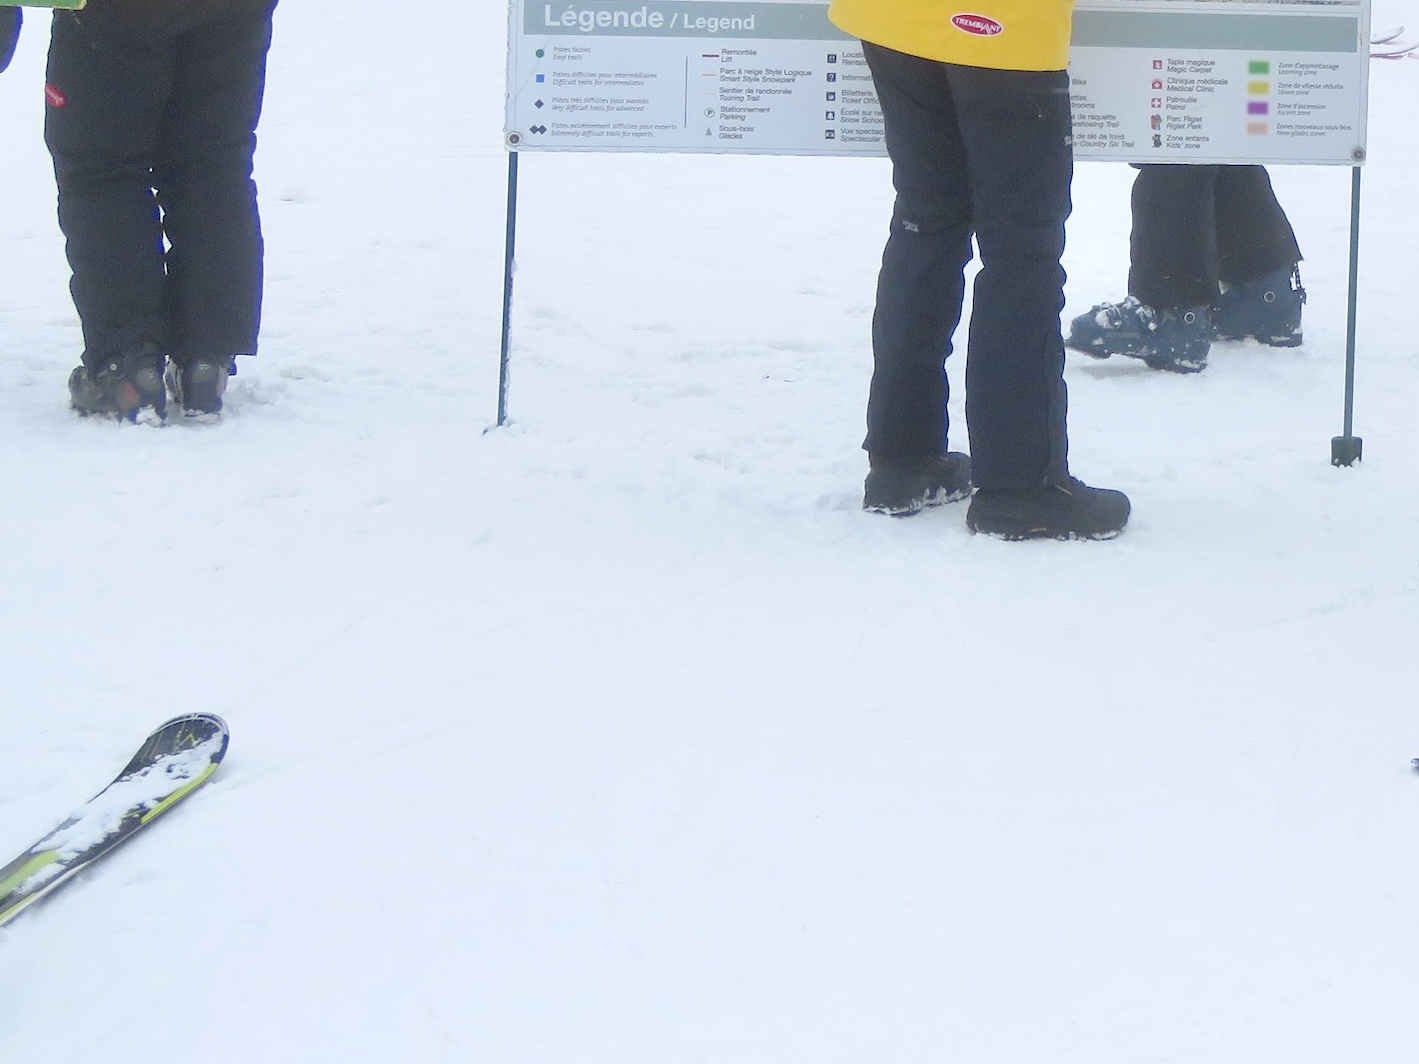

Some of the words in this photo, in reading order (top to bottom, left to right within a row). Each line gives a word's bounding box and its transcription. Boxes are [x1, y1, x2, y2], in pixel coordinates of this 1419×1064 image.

[544, 4, 664, 32] Légende
[683, 13, 755, 33] Legend
[955, 17, 1000, 35] TREMBLANT
[1186, 60, 1216, 68] magique
[1294, 63, 1340, 71] d'apprentissage
[1166, 66, 1187, 74] Magic
[841, 88, 873, 96] Billetterie
[840, 107, 860, 116] École
